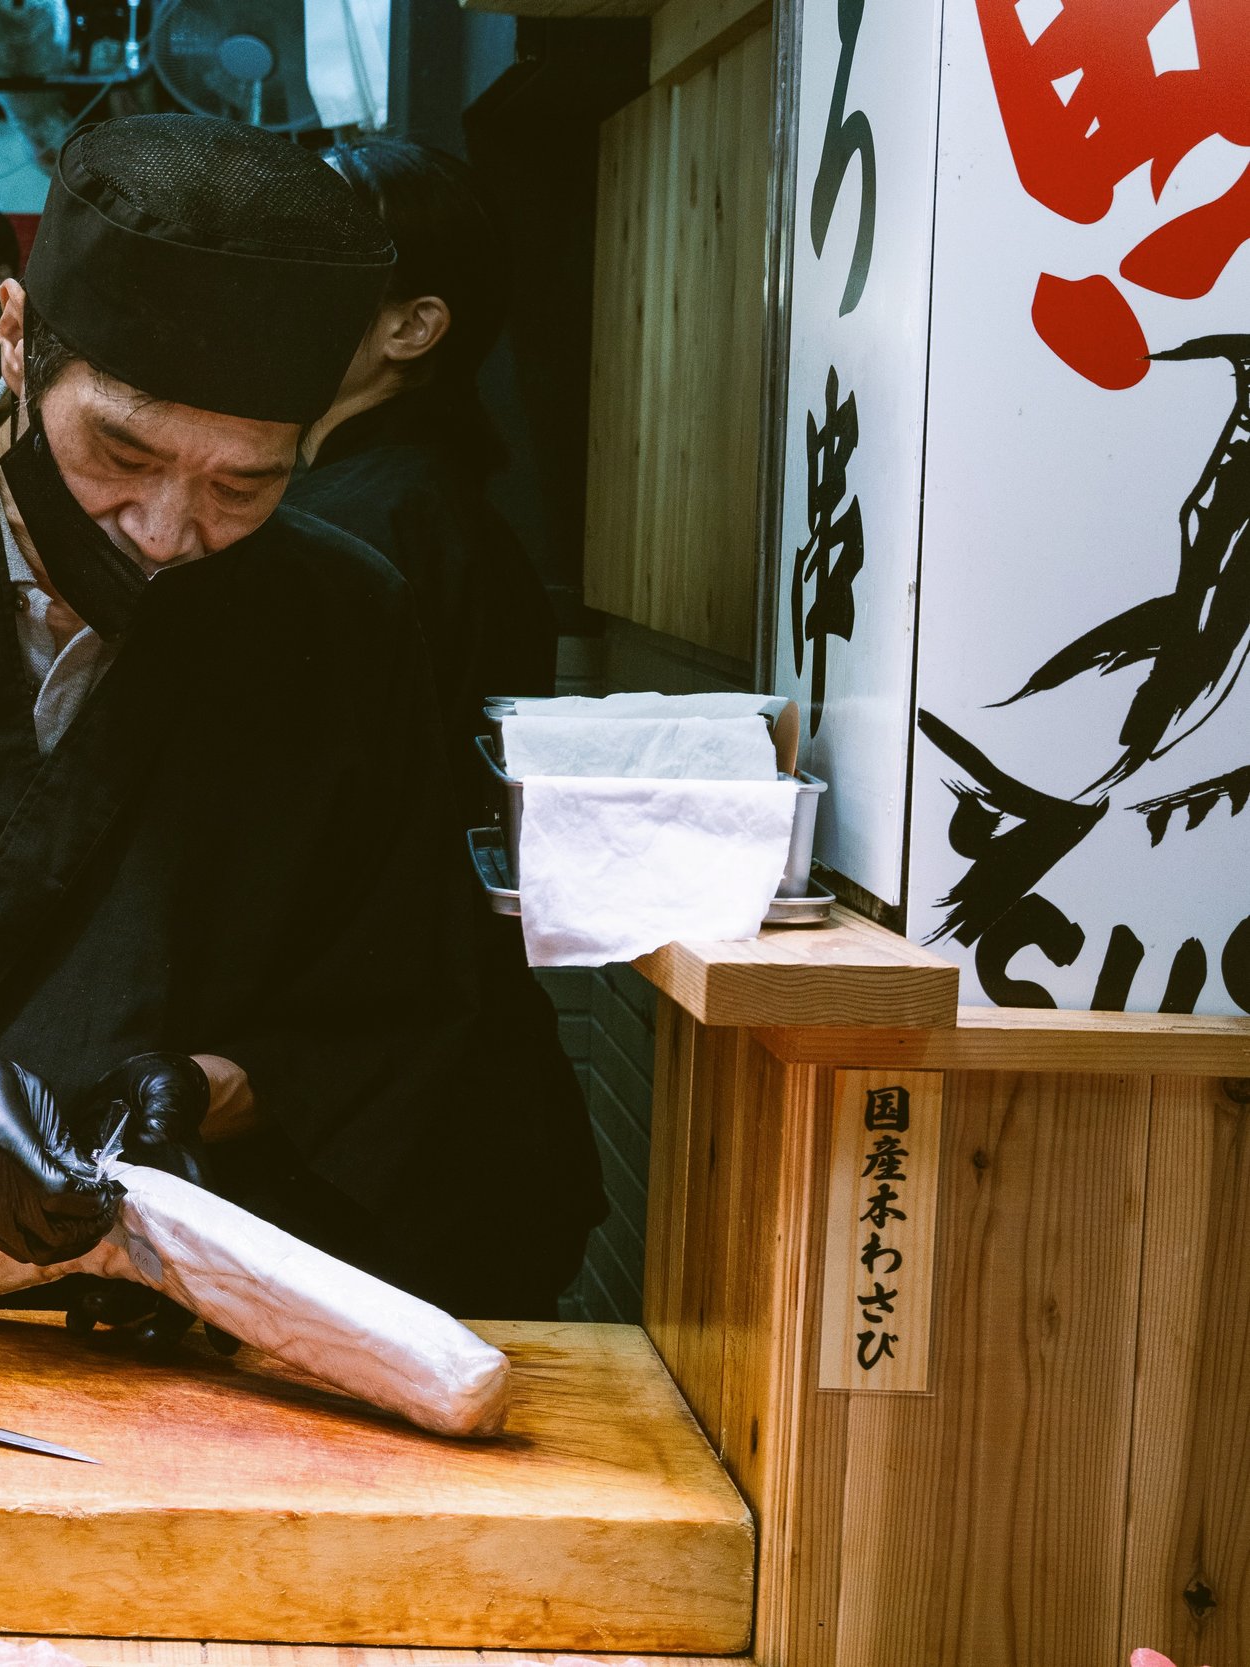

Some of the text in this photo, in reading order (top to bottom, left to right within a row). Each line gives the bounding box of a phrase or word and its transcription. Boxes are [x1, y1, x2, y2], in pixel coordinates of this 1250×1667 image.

[857, 1085, 910, 1371] 国産本わさび
